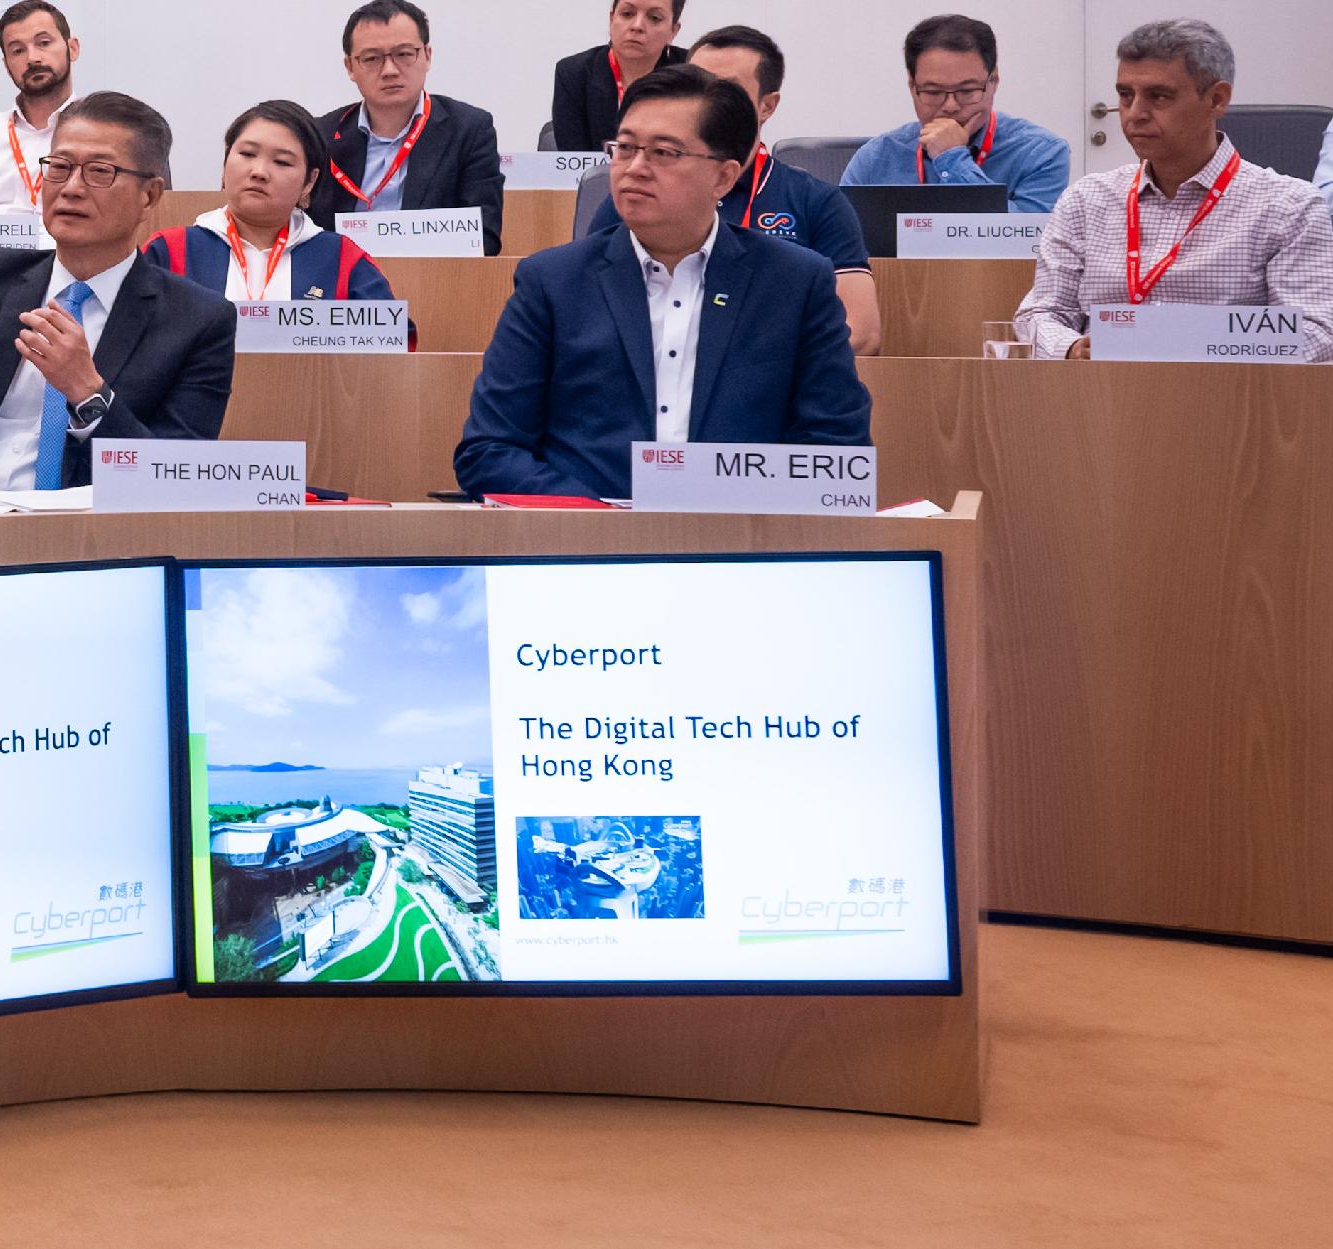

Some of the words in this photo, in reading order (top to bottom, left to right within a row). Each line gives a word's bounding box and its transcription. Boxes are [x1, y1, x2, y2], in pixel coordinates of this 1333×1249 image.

[349, 220, 368, 229] IESE
[378, 222, 406, 235] DR.
[412, 219, 479, 235] LINXIAN
[913, 219, 933, 228] IESE
[947, 226, 973, 238] DR.
[471, 240, 480, 248] LI
[249, 307, 270, 317] IESE
[278, 307, 320, 326] MS.
[330, 307, 403, 326] EMILY
[1111, 311, 1135, 322] IESE
[1228, 308, 1297, 334] IVÁN
[293, 336, 346, 346] CHEUNG
[349, 336, 374, 346] TAK
[377, 336, 403, 346] YAN
[1207, 343, 1298, 356] RODRÍGUEZ
[114, 451, 138, 464] IESE
[657, 450, 684, 464] IESE
[151, 463, 191, 480] THE
[197, 464, 241, 480] HON
[248, 464, 301, 481] PAUL
[716, 452, 775, 478] MR.
[789, 454, 870, 480] ERIC
[257, 492, 300, 506] CHAN
[821, 494, 871, 508] CHAN
[517, 643, 662, 671] Cyberport
[35, 725, 80, 750] Hub
[88, 722, 111, 746] of
[519, 717, 573, 739] The
[585, 716, 675, 745] Digital
[685, 715, 752, 739] Tech
[764, 715, 821, 738] Hub
[832, 714, 861, 738] of
[521, 754, 592, 783] Hong
[604, 754, 673, 782] Kong
[98, 881, 144, 901] 數碼港
[847, 877, 905, 895] 數碼港
[741, 889, 910, 930] Cyberport
[13, 900, 147, 939] Cyberport
